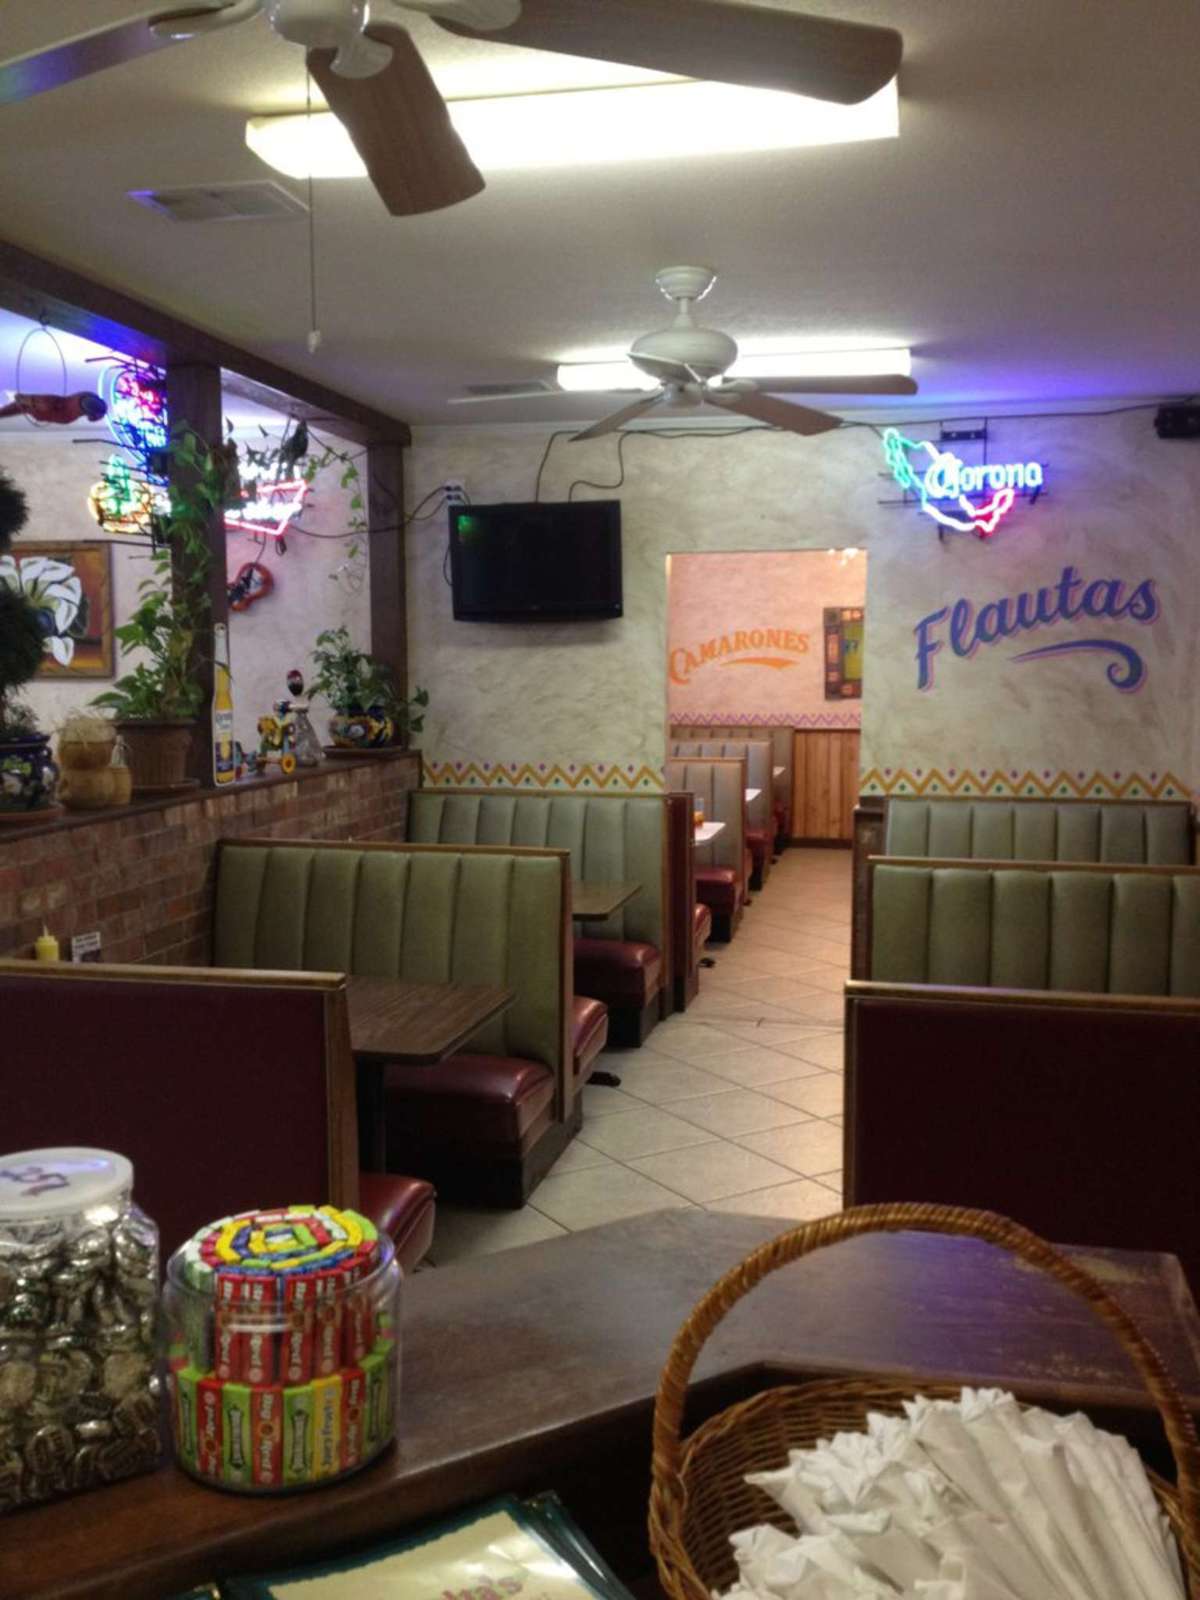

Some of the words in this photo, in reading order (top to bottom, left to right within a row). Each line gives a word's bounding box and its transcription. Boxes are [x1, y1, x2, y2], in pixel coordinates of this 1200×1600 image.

[924, 452, 1043, 498] Corona
[669, 627, 810, 685] CAMARONES
[913, 566, 1161, 691] Flautas
